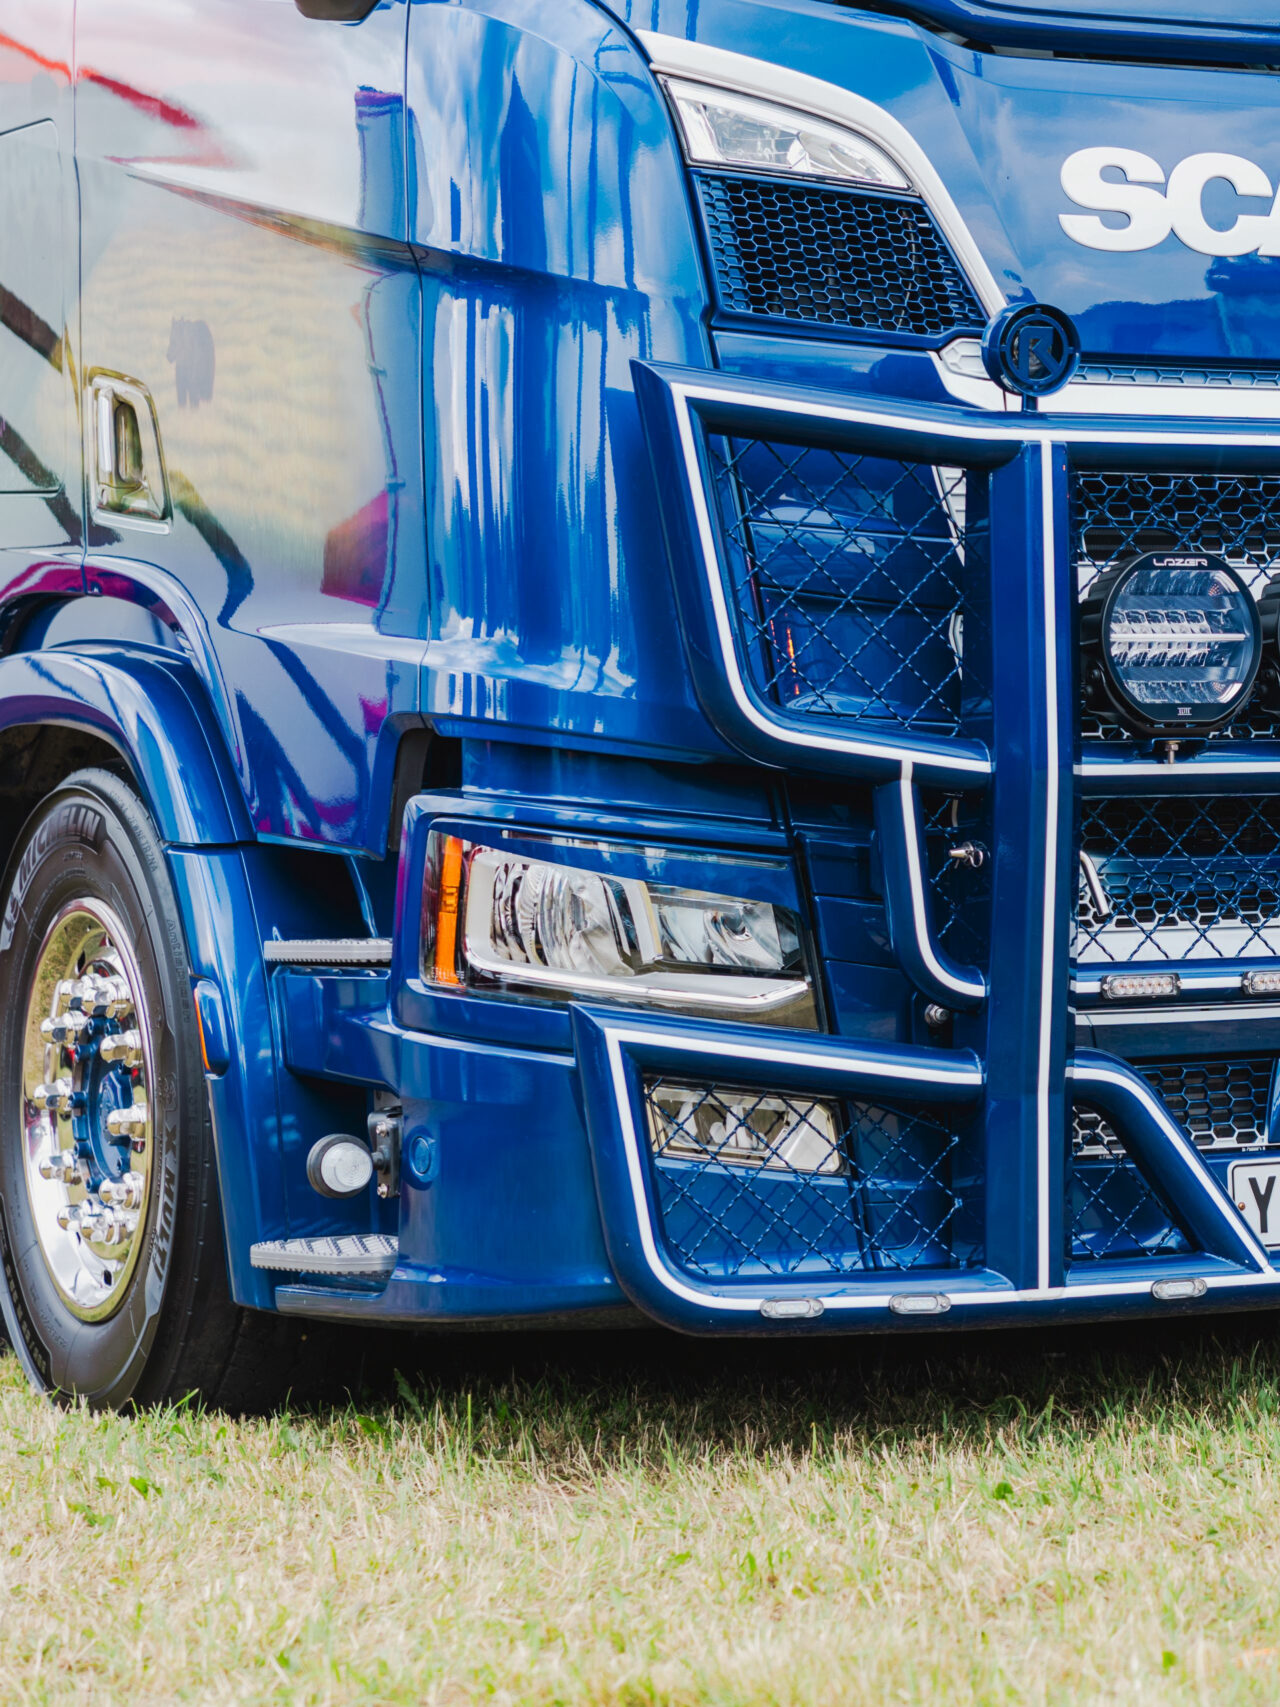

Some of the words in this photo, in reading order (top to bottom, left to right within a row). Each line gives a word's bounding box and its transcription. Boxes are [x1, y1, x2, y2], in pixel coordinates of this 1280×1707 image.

[1153, 558, 1208, 567] LAZER
[18, 806, 101, 893] MICHELIN
[152, 1165, 176, 1283] MULTI
